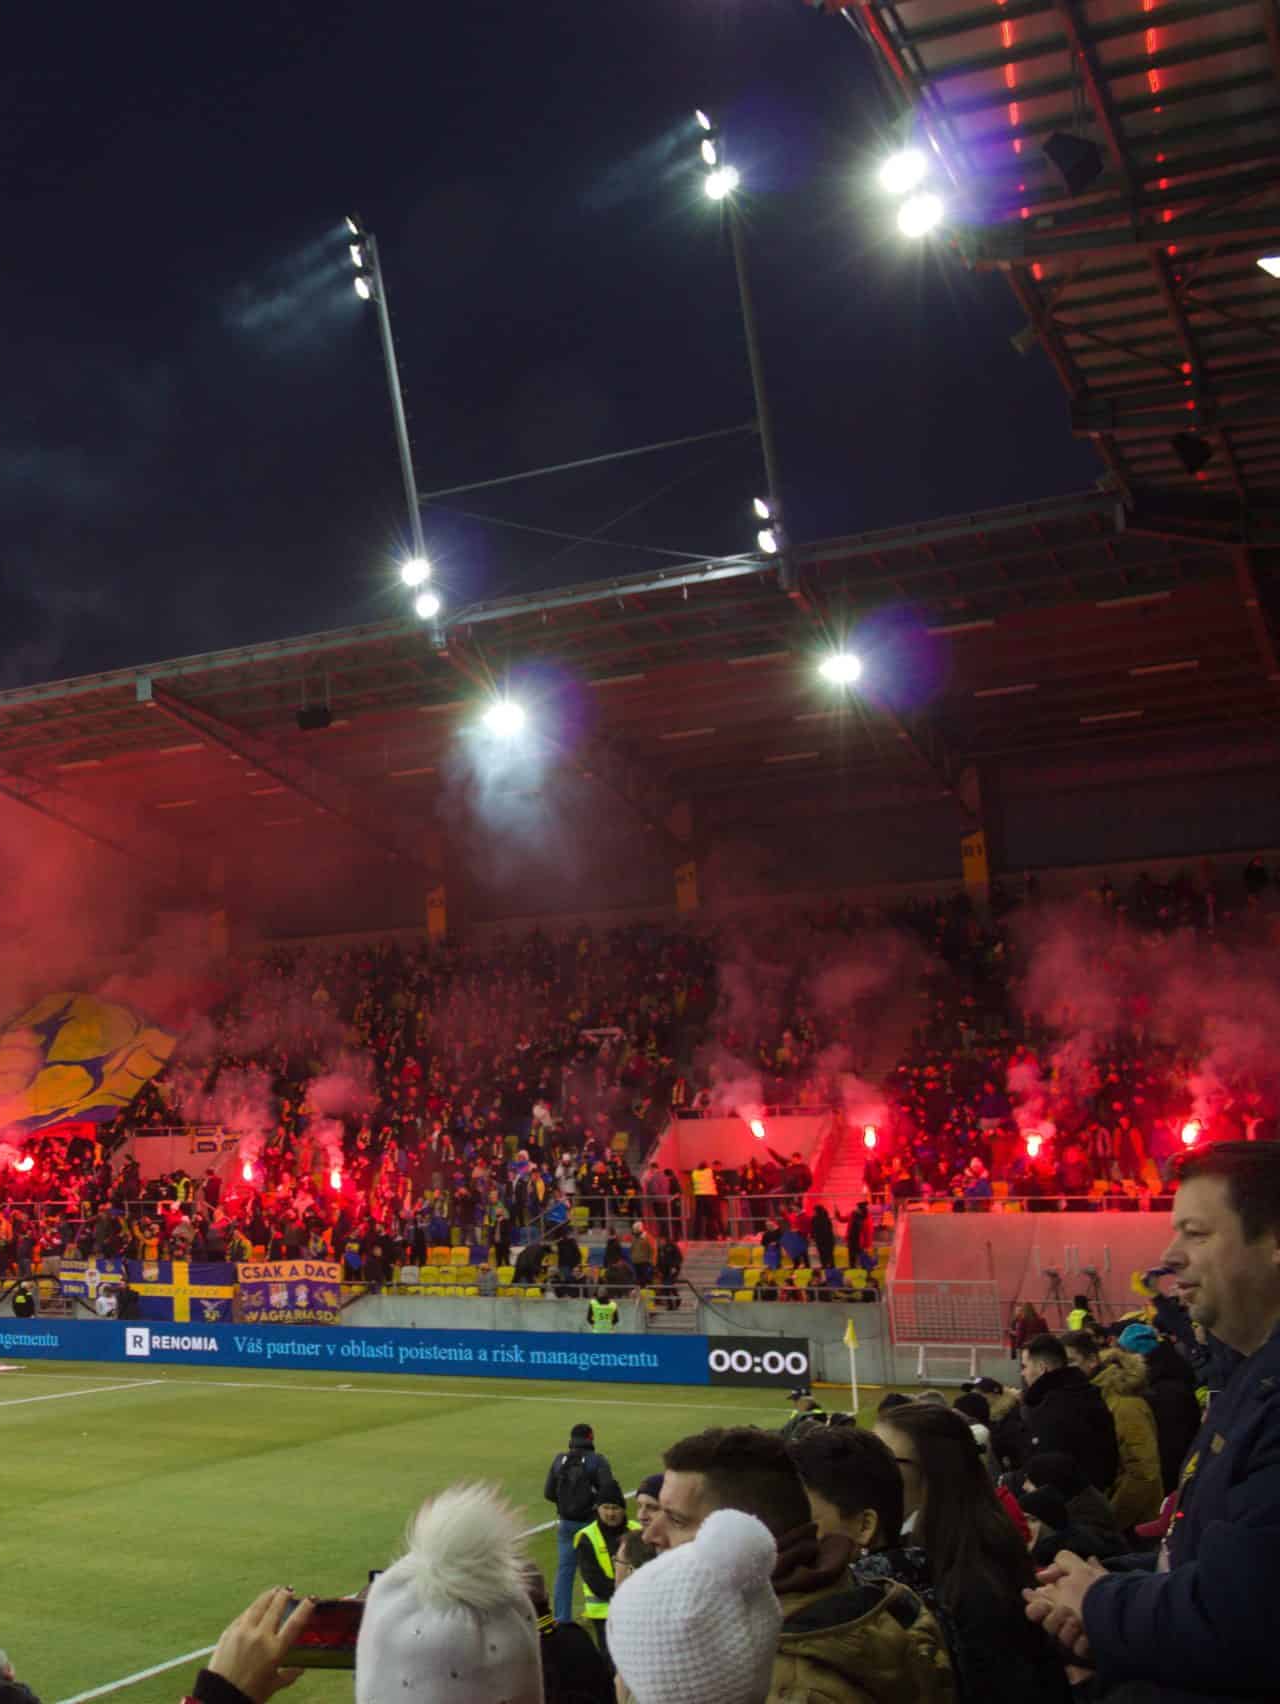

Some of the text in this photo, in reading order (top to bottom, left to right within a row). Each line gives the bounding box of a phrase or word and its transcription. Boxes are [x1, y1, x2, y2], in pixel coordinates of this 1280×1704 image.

[241, 1263, 337, 1279] CSAK A DAC
[133, 1335, 144, 1349] R
[151, 1335, 218, 1351] RENOMIA
[233, 1335, 659, 1370] Váš partner v oblasti poistenia a risk managementu
[707, 1349, 809, 1375] 00:00
